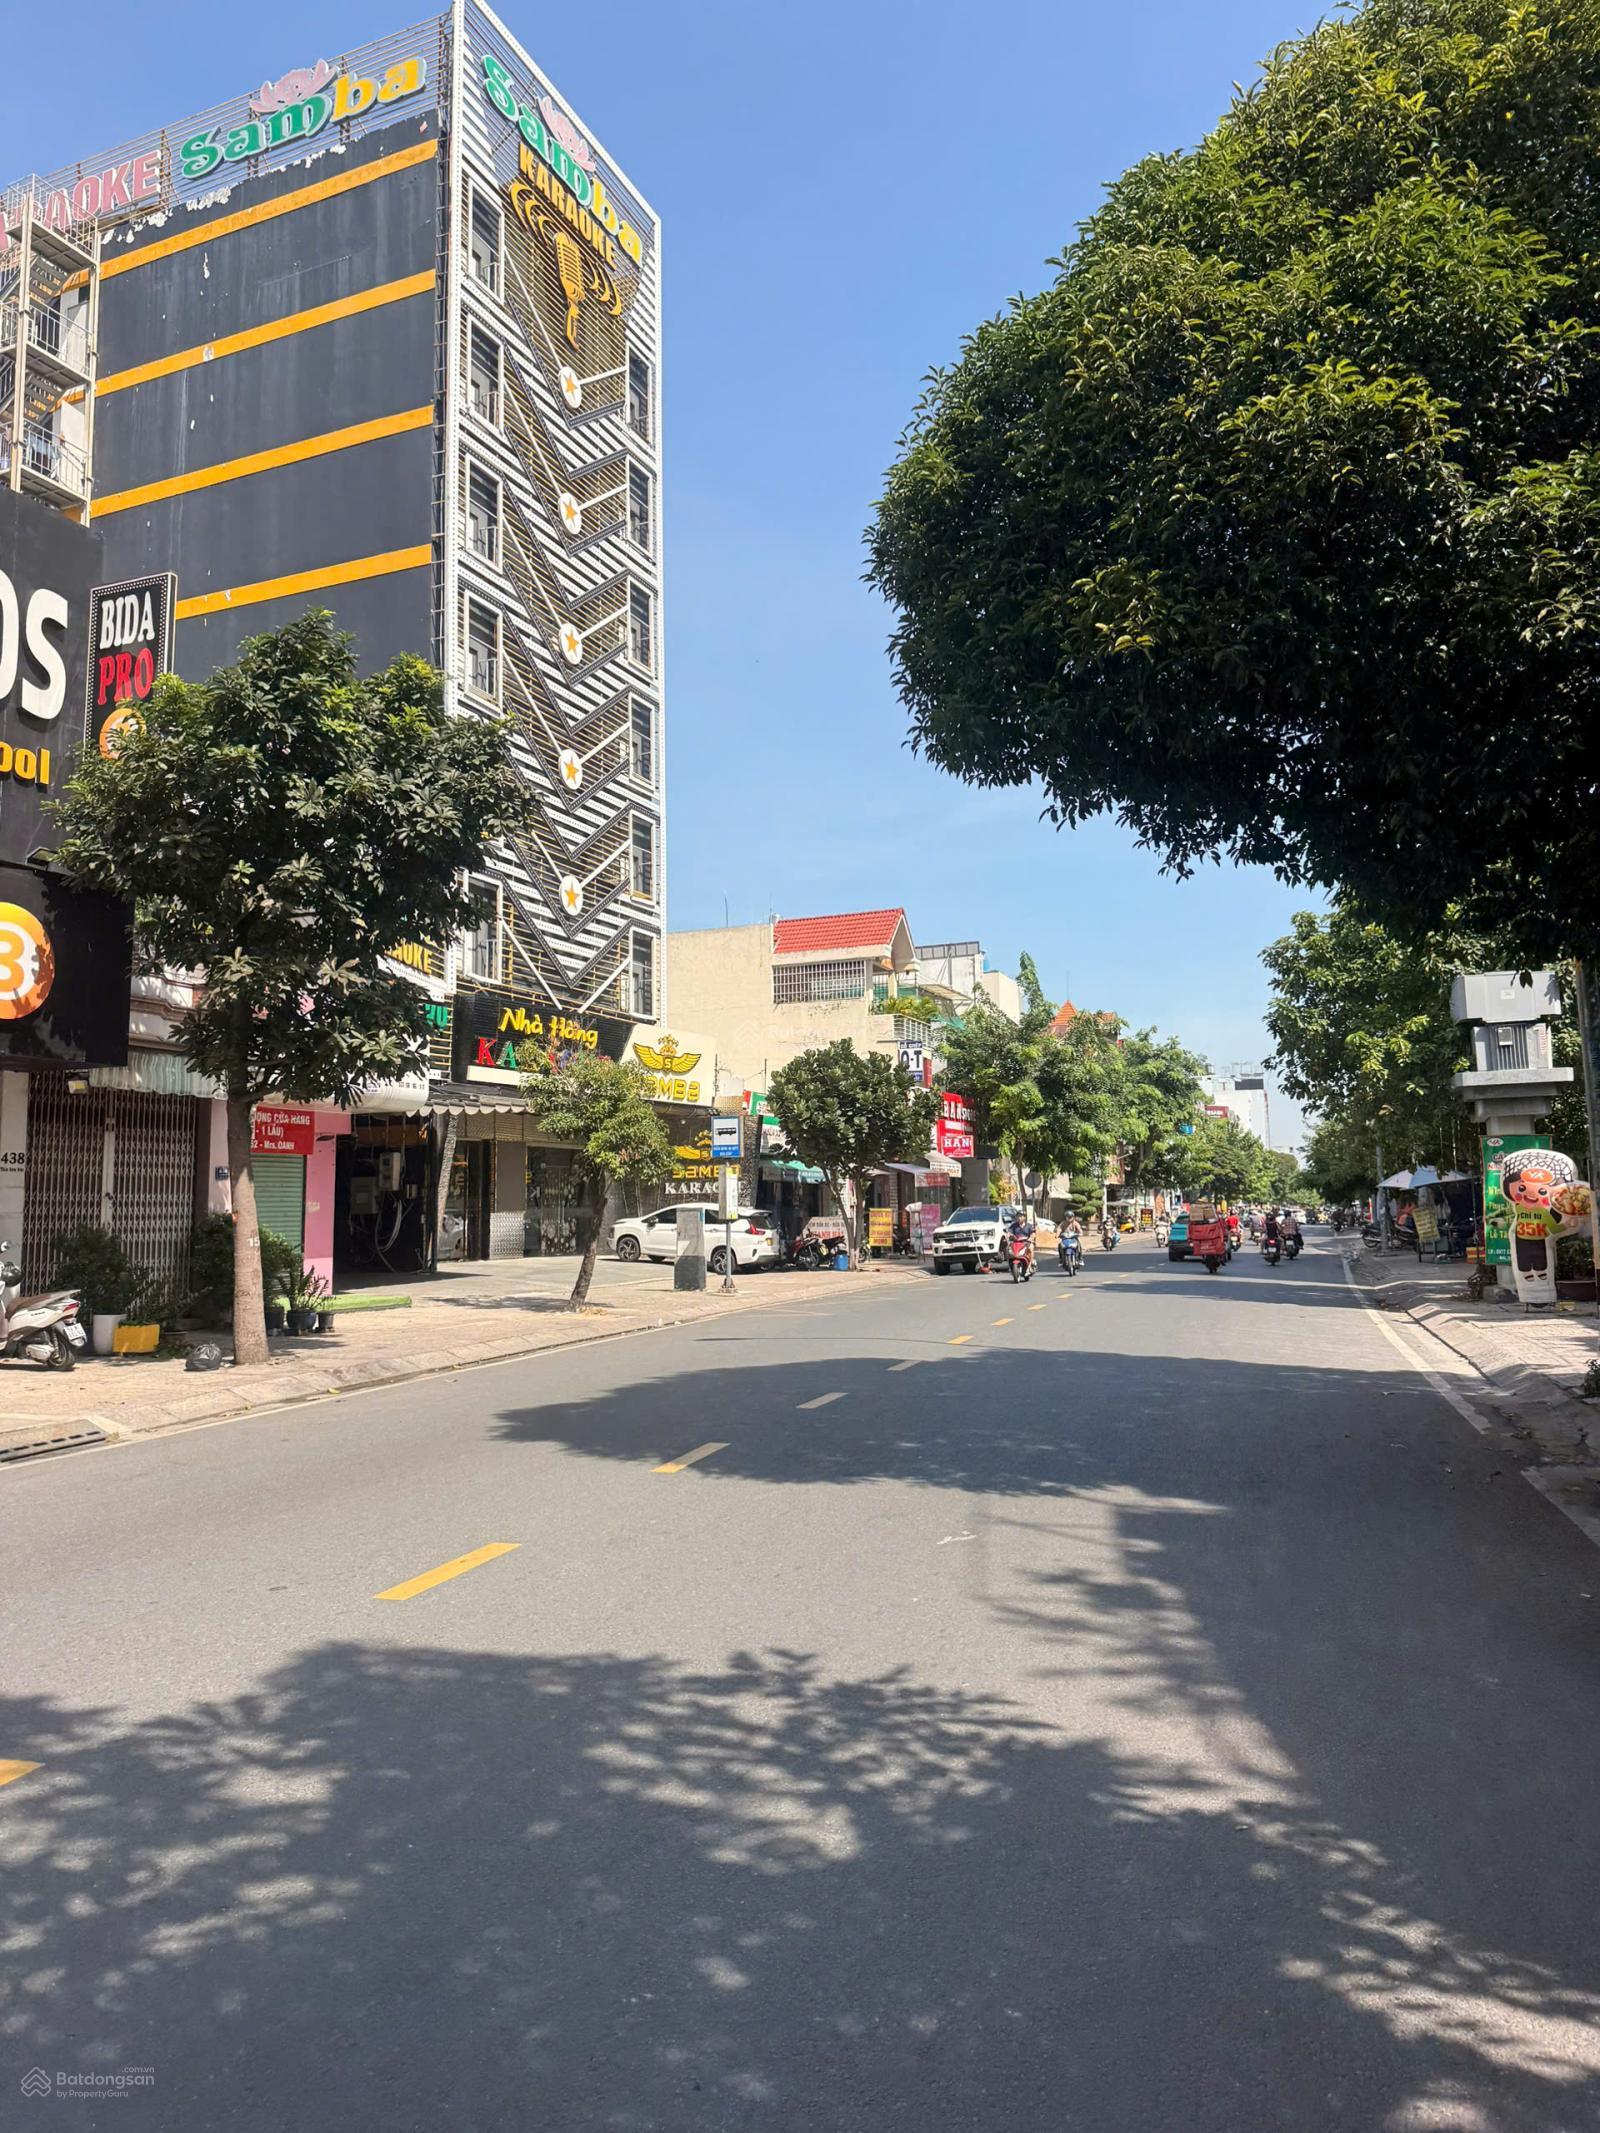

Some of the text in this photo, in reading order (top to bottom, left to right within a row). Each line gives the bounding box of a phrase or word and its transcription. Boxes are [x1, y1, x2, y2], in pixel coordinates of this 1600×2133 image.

[180, 56, 427, 179] Samba
[480, 54, 643, 267] Samba
[518, 142, 618, 271] KARAOKE
[100, 590, 155, 649] BIDA
[98, 647, 154, 705] PRO
[1, 1151, 25, 1165] 438
[1516, 1222, 1548, 1237] 35K
